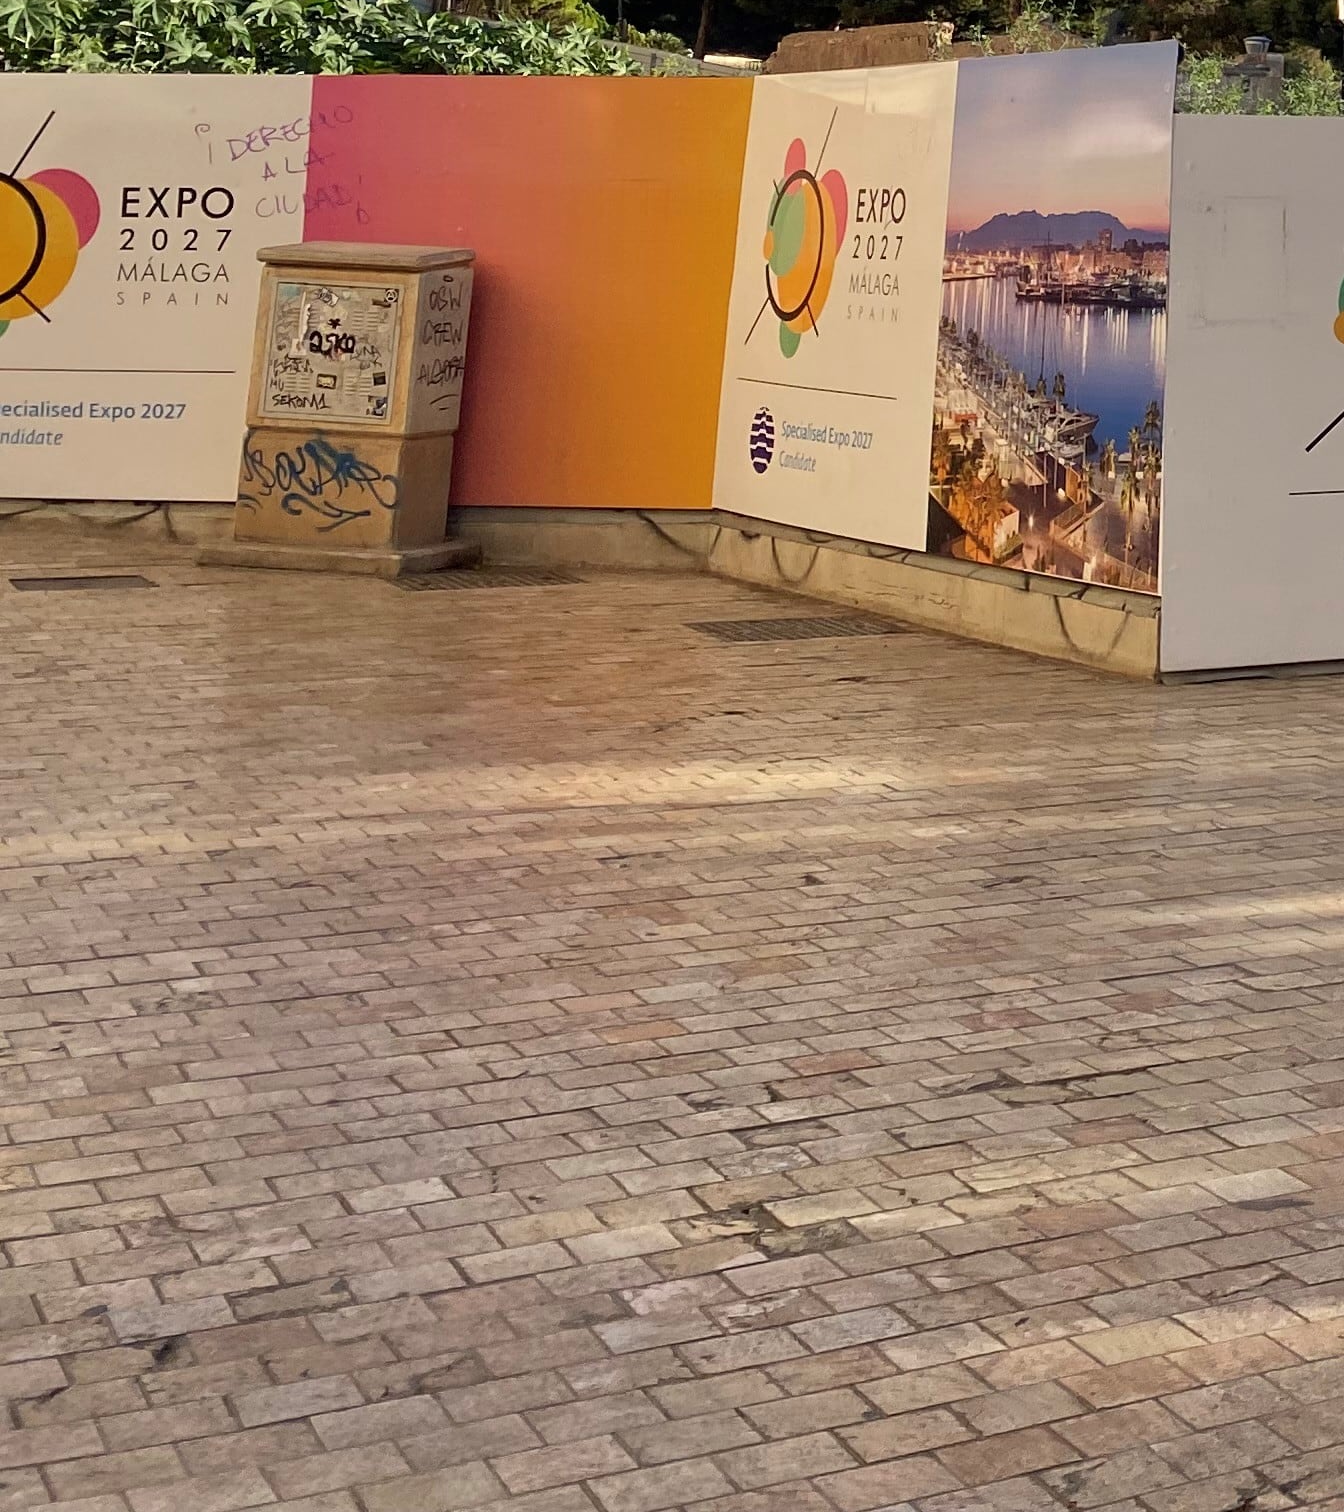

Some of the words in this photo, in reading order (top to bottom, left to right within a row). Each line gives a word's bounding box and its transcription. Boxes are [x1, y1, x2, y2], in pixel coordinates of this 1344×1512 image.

[121, 186, 235, 219] EXPO
[856, 187, 906, 224] EXPO
[119, 228, 233, 252] 2027
[852, 234, 903, 260] 2027
[116, 255, 230, 283] MÁLAGA
[848, 266, 900, 296] MÁLAGA
[116, 291, 229, 306] SPAIN
[847, 304, 899, 323] SPAIN
[89, 403, 136, 422] Expo
[140, 403, 187, 419] 2027
[781, 420, 828, 444] Specialised
[828, 427, 850, 450] Expo
[851, 430, 873, 450] 2027
[779, 450, 817, 473] Candidate
